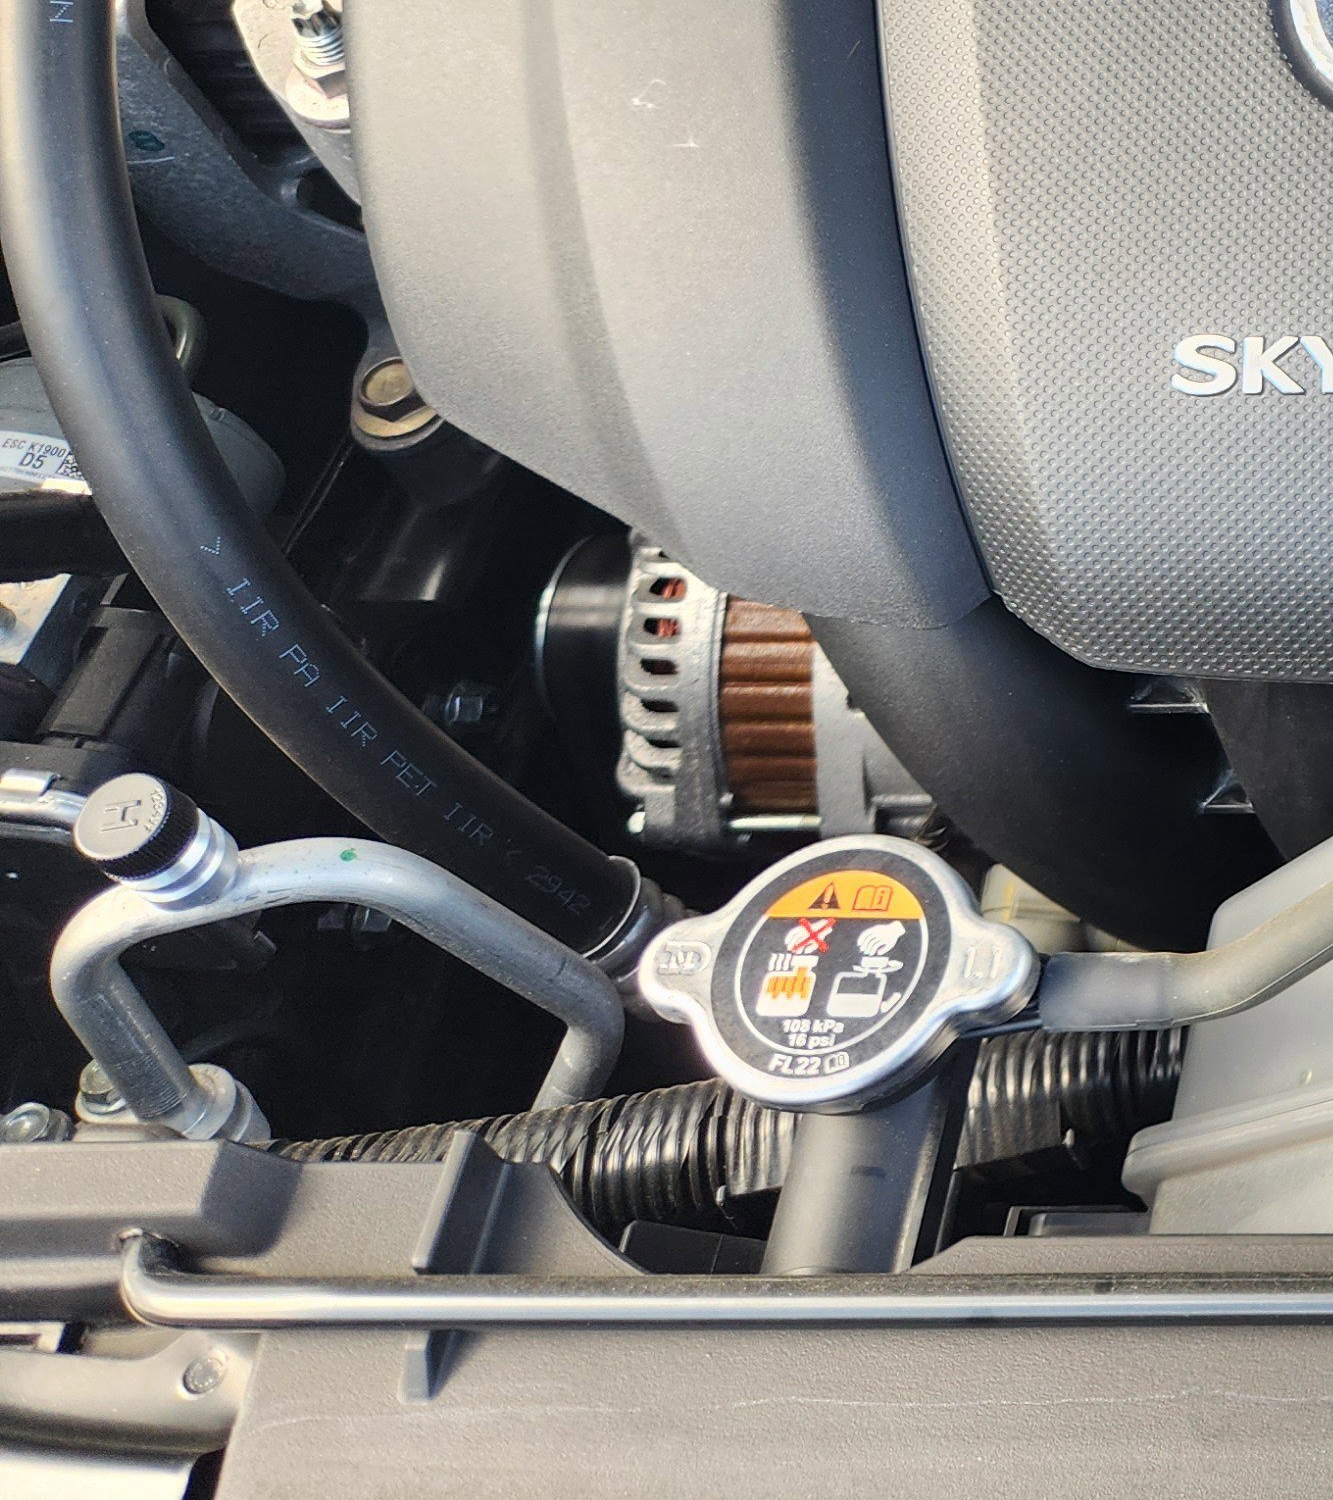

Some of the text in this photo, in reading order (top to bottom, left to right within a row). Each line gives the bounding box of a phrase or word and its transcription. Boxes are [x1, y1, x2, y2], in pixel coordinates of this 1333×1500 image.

[2, 438, 67, 458] ESC K1900
[18, 451, 47, 470] D5
[278, 644, 320, 687] PA
[380, 750, 437, 796] PET
[812, 1018, 845, 1035] kPa
[787, 1033, 808, 1048] 16
[768, 1052, 822, 1076] FL22
